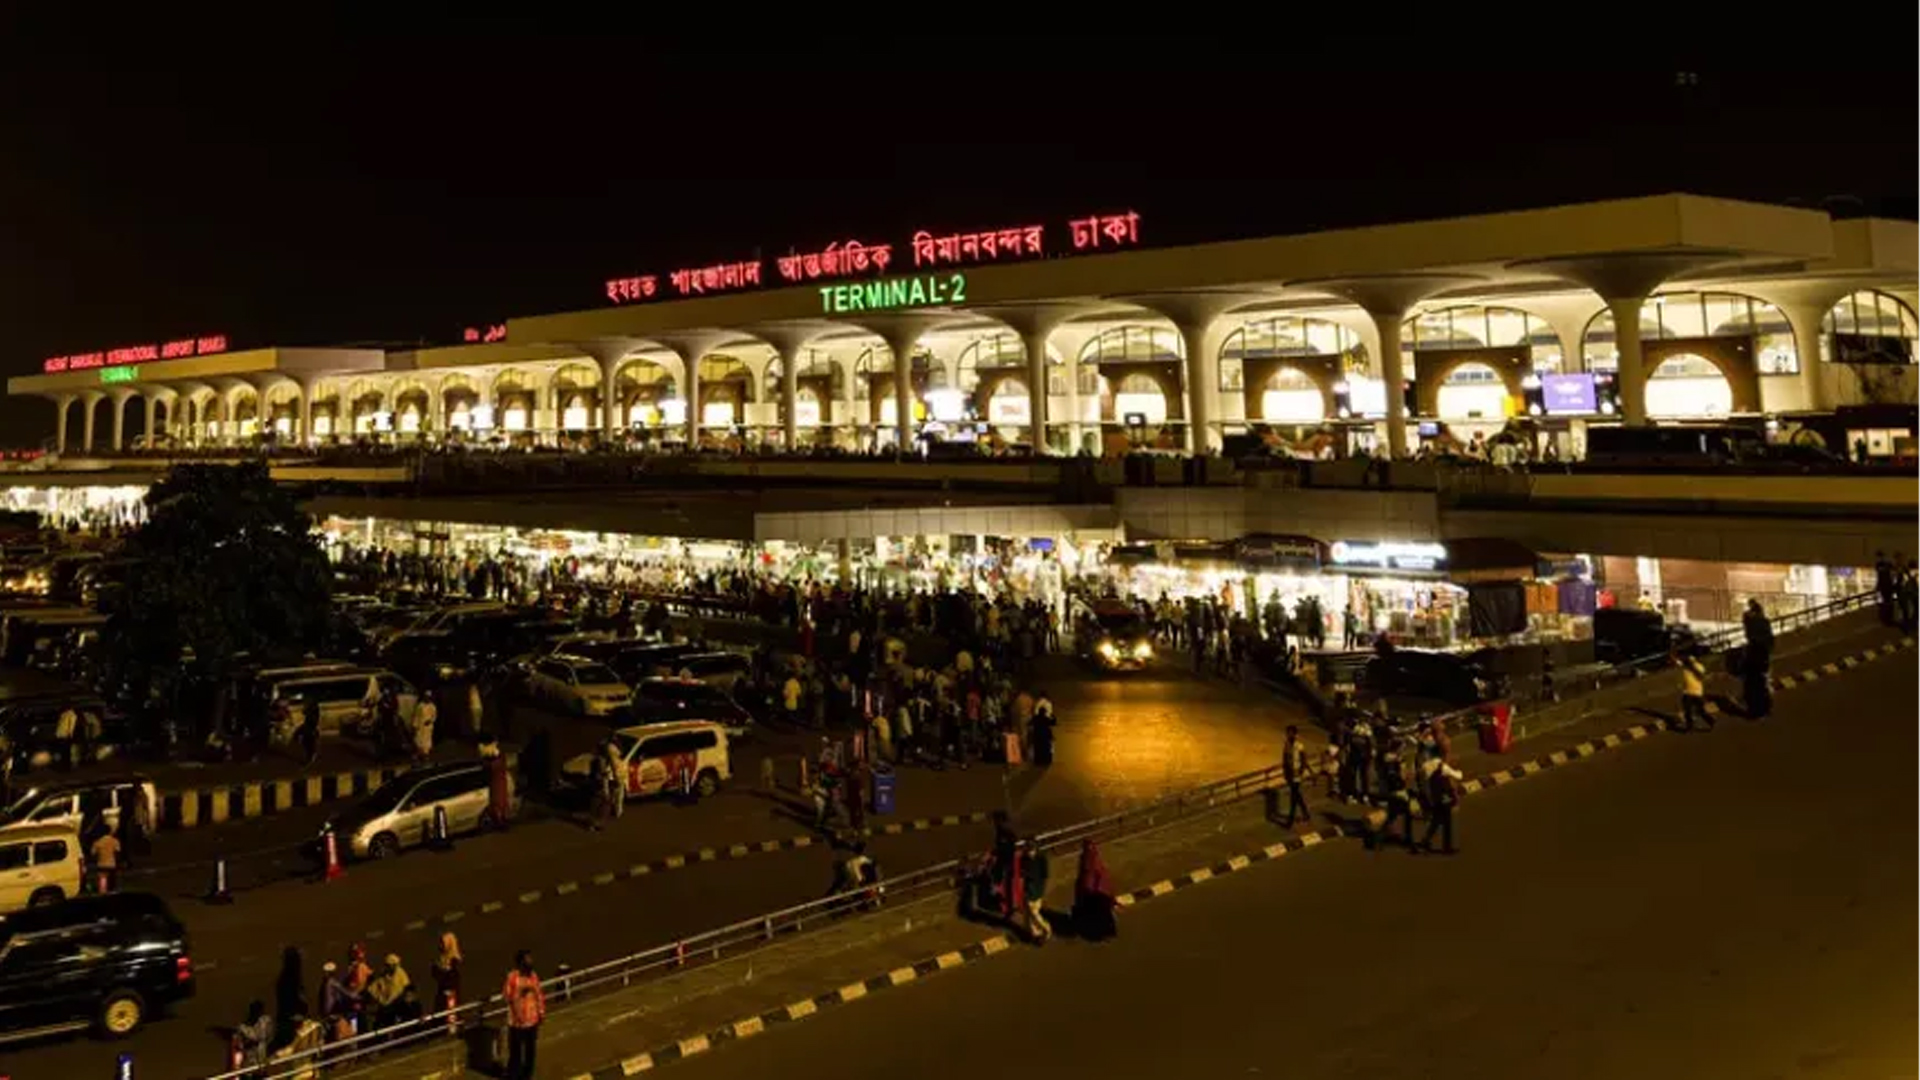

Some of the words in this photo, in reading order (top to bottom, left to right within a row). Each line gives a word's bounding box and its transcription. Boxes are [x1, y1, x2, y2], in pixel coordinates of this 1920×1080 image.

[606, 275, 656, 303] হযরত
[670, 261, 762, 294] শাহজালাল
[778, 241, 892, 280] আন্তর্জাতিক
[912, 225, 1043, 266] বিমানবন্দর
[1069, 211, 1141, 249] ঢাকা
[820, 274, 965, 312] TERMINAL-2
